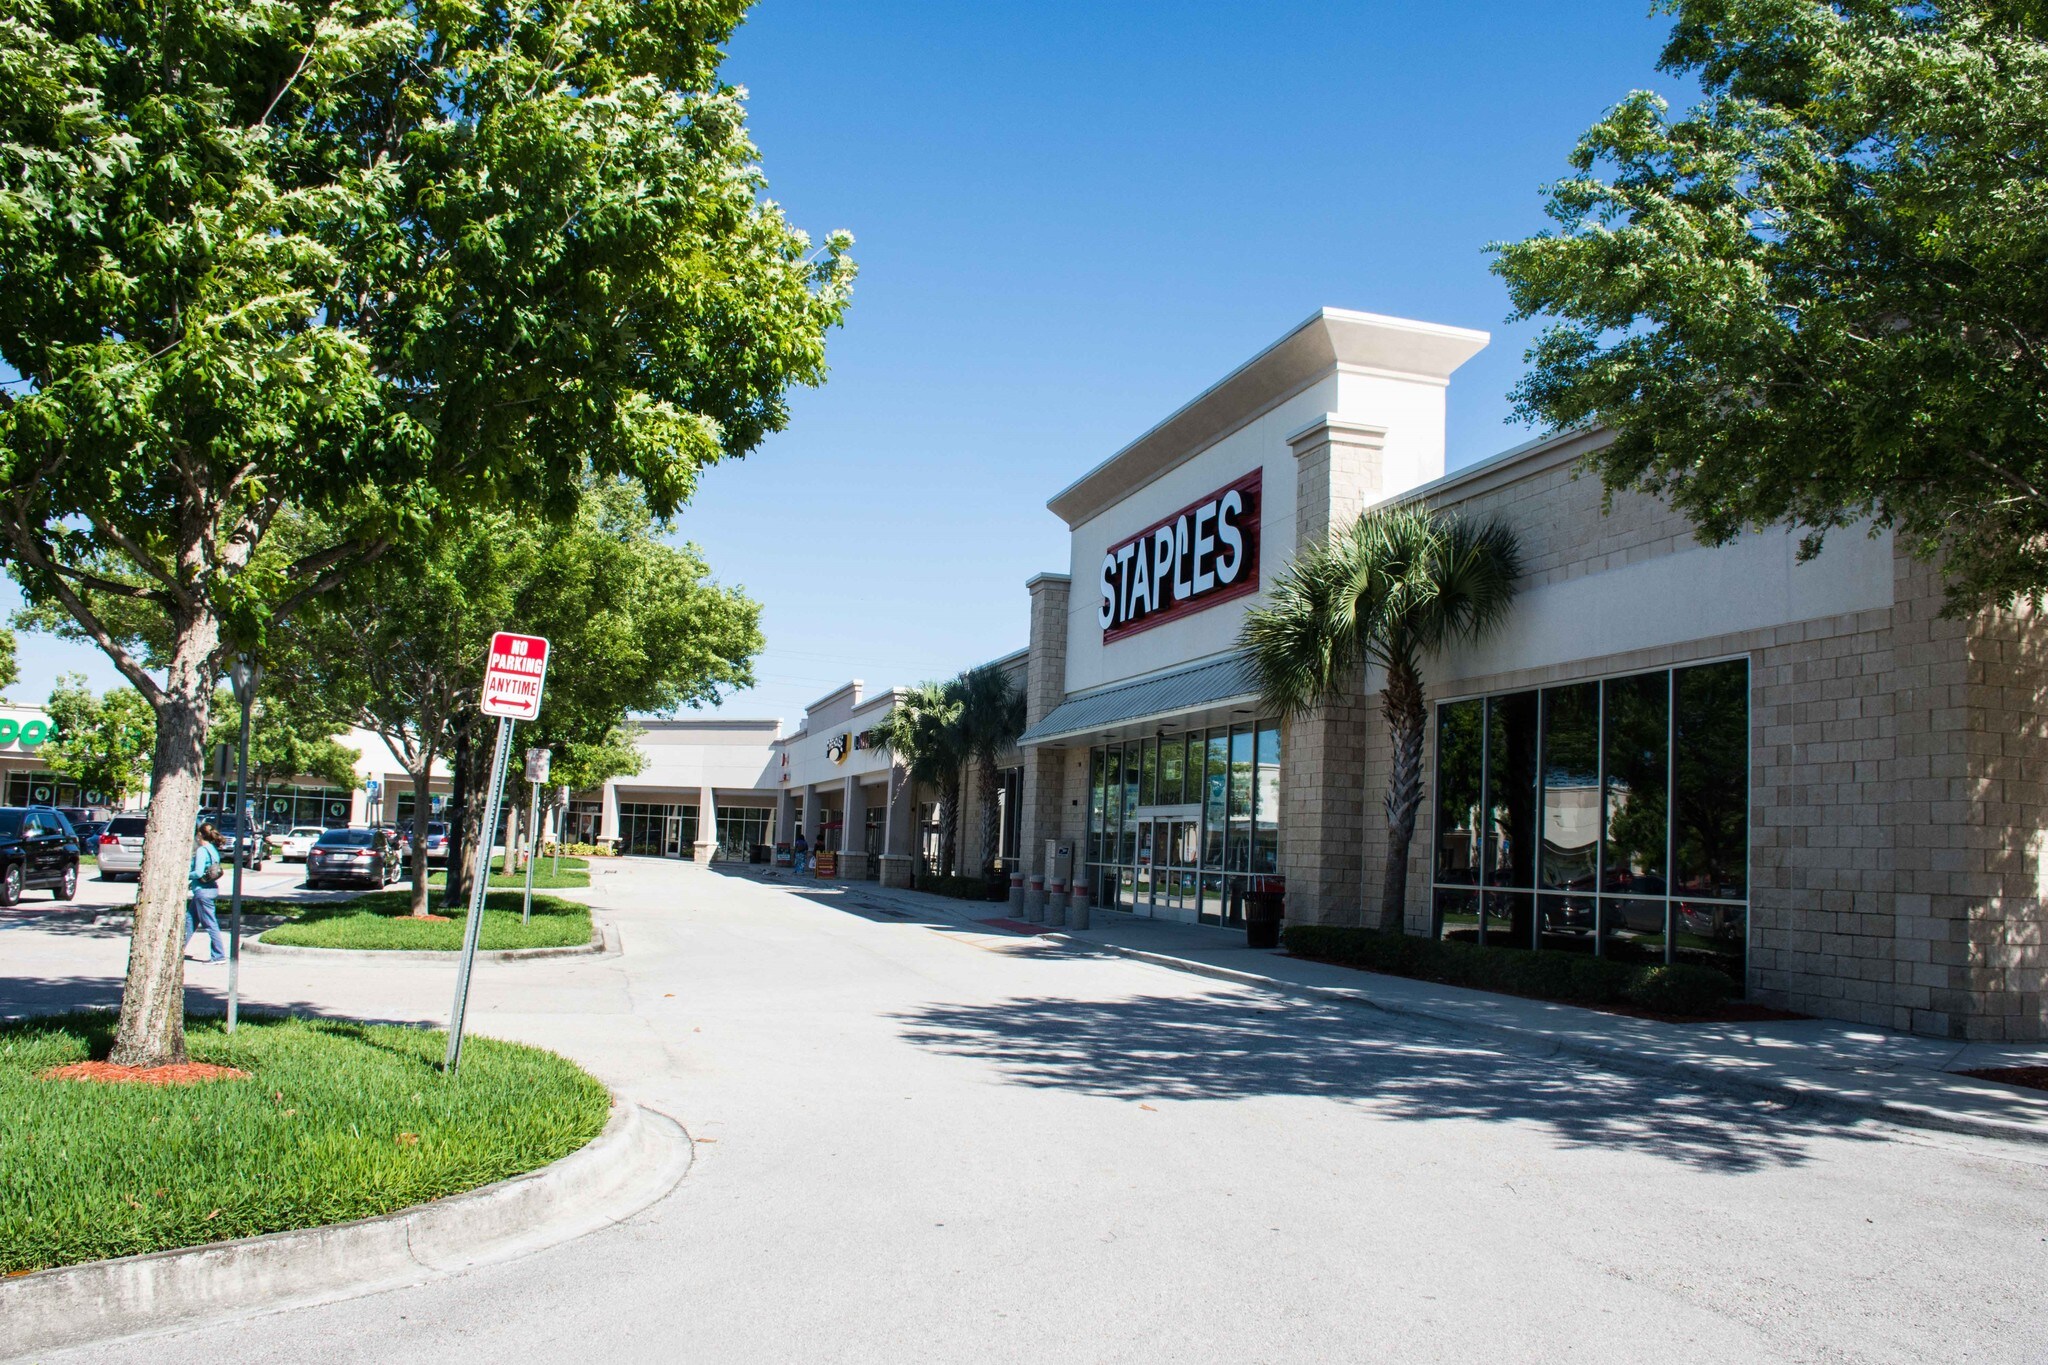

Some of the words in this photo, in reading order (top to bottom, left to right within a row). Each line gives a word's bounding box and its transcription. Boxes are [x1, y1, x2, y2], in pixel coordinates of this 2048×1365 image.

[1098, 489, 1242, 630] STAPLES
[511, 640, 529, 656] NO
[491, 653, 543, 674] PARKING
[490, 677, 537, 696] ANYTIME
